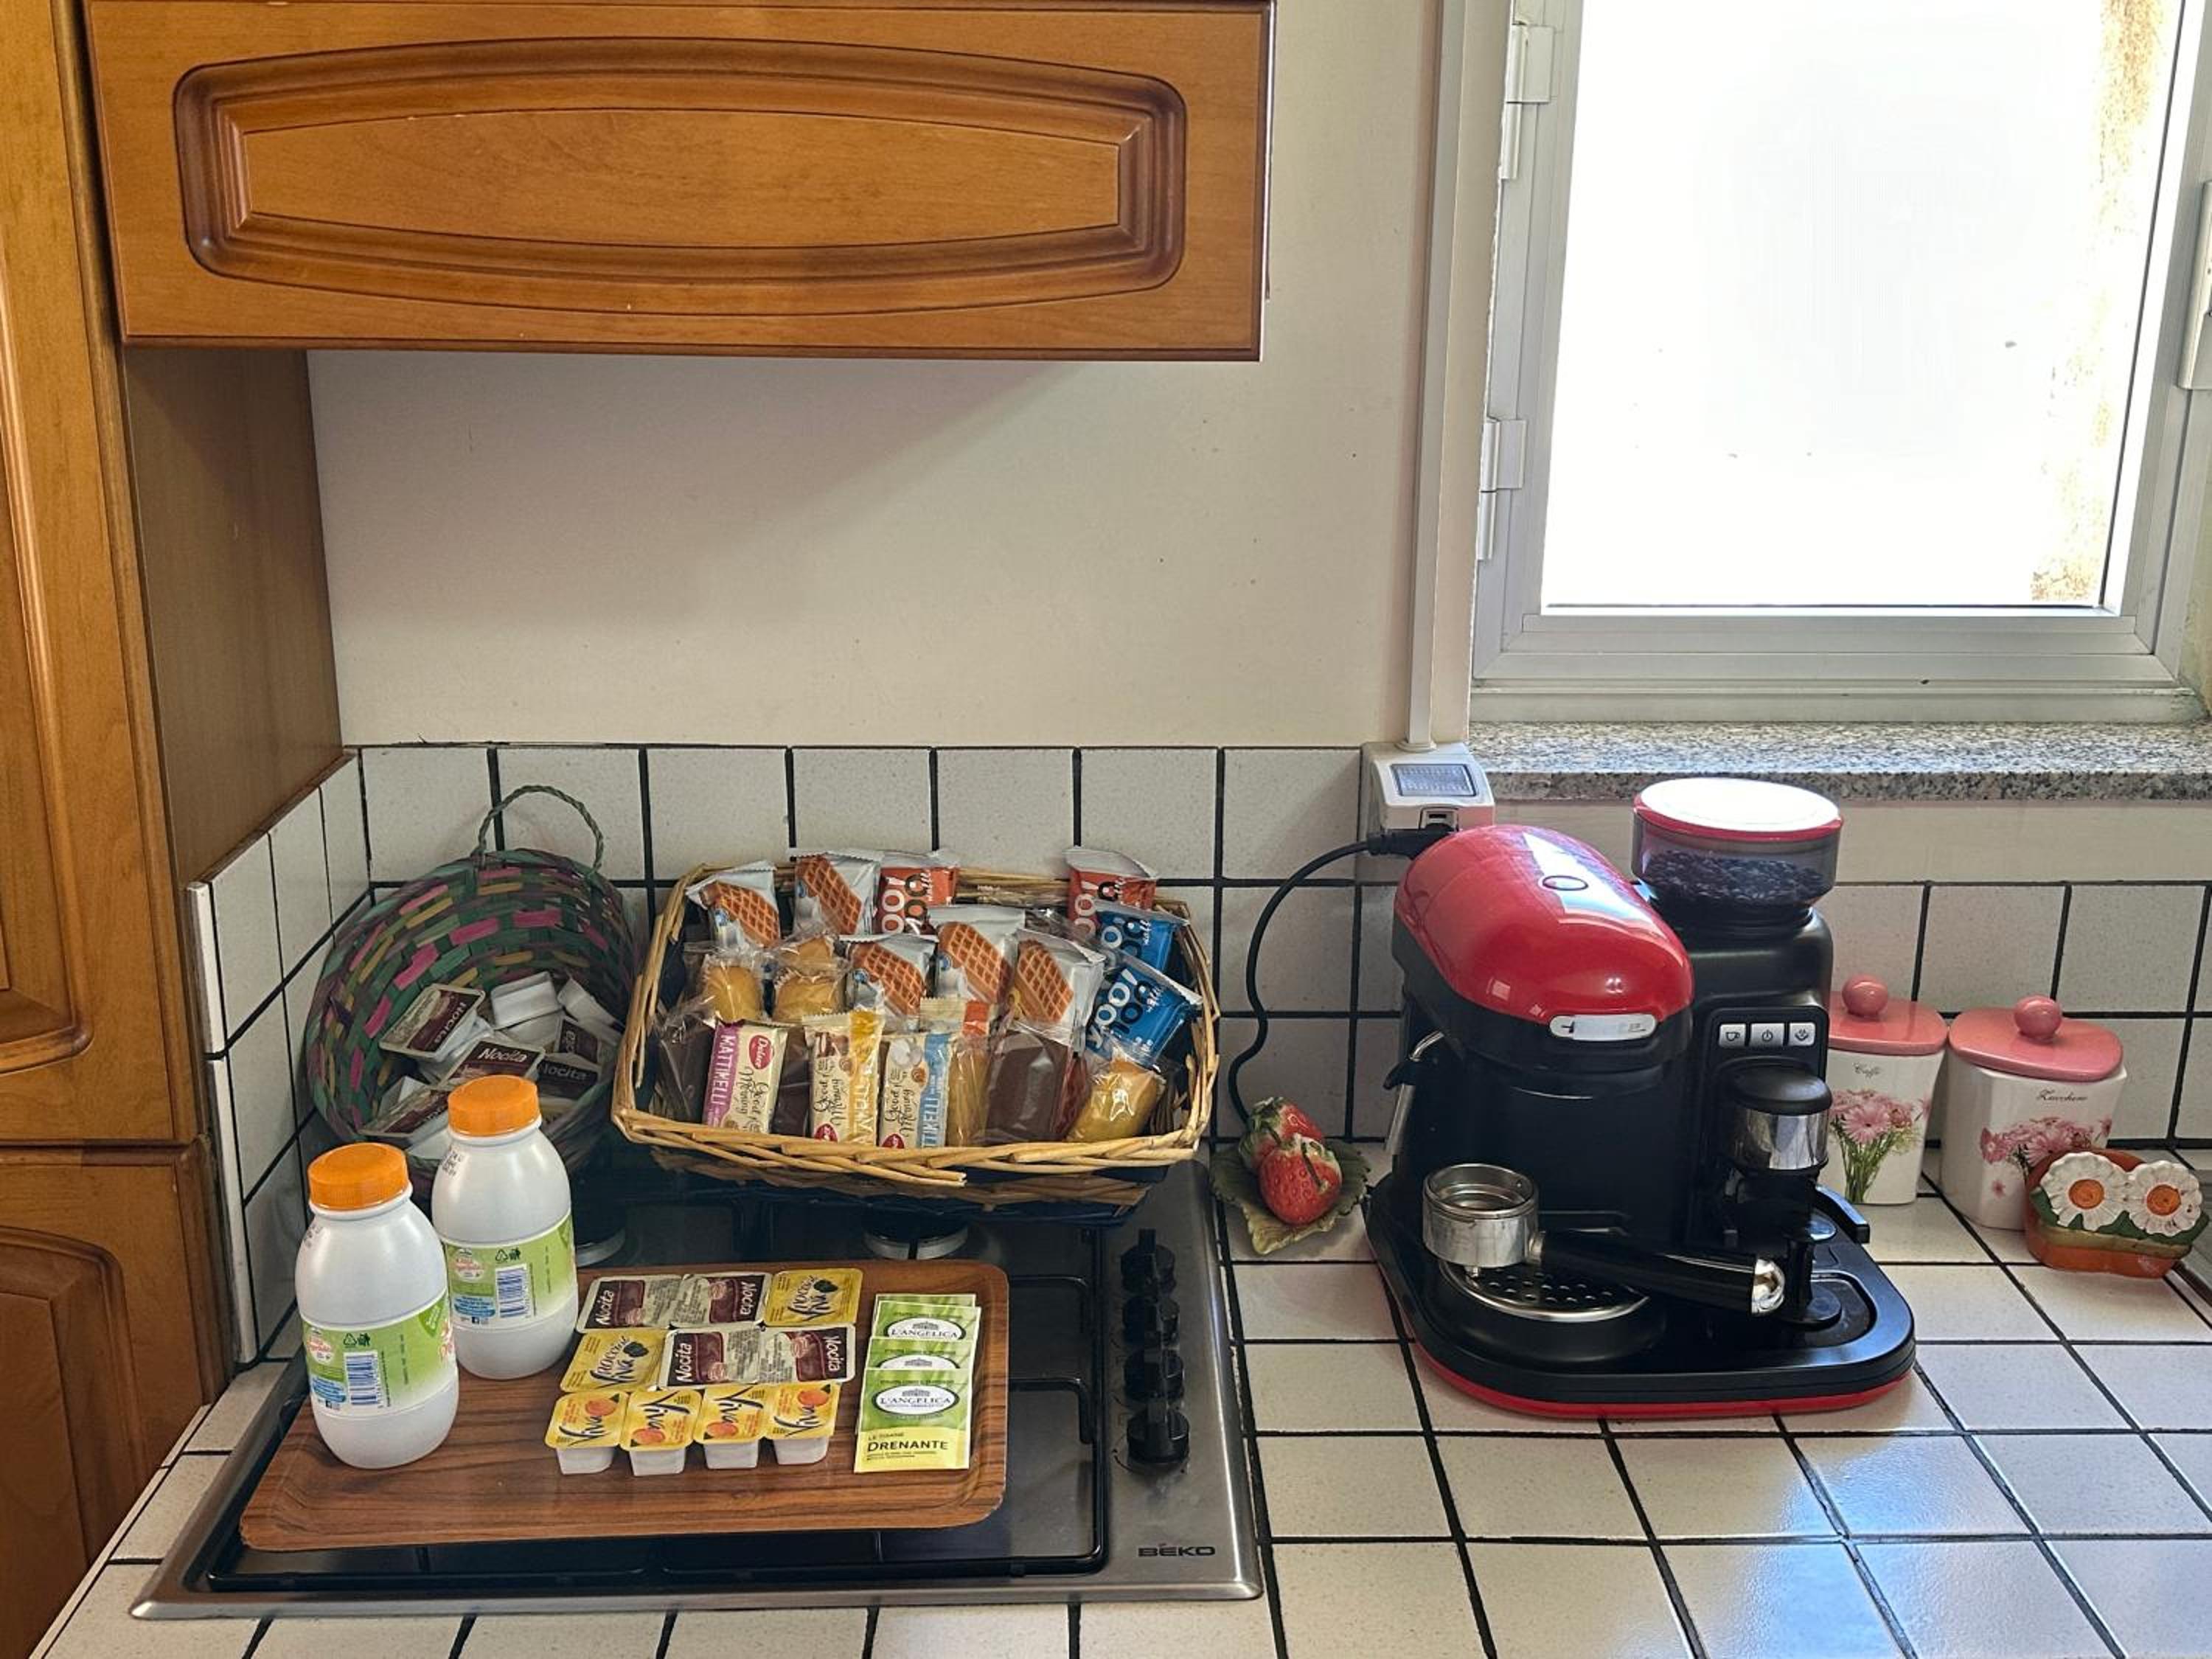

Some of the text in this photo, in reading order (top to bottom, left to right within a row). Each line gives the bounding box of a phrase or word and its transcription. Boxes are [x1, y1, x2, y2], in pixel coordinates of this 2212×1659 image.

[479, 1047, 528, 1062] Nocita
[595, 1290, 615, 1326] Nocita
[740, 1281, 757, 1316] Nocita
[891, 1329, 958, 1338] L'ANGELICA
[675, 1342, 694, 1383] Nocita
[824, 1333, 842, 1372] Nocita
[867, 1440, 949, 1452] DRENANTE
[1138, 1545, 1216, 1557] BEKO
